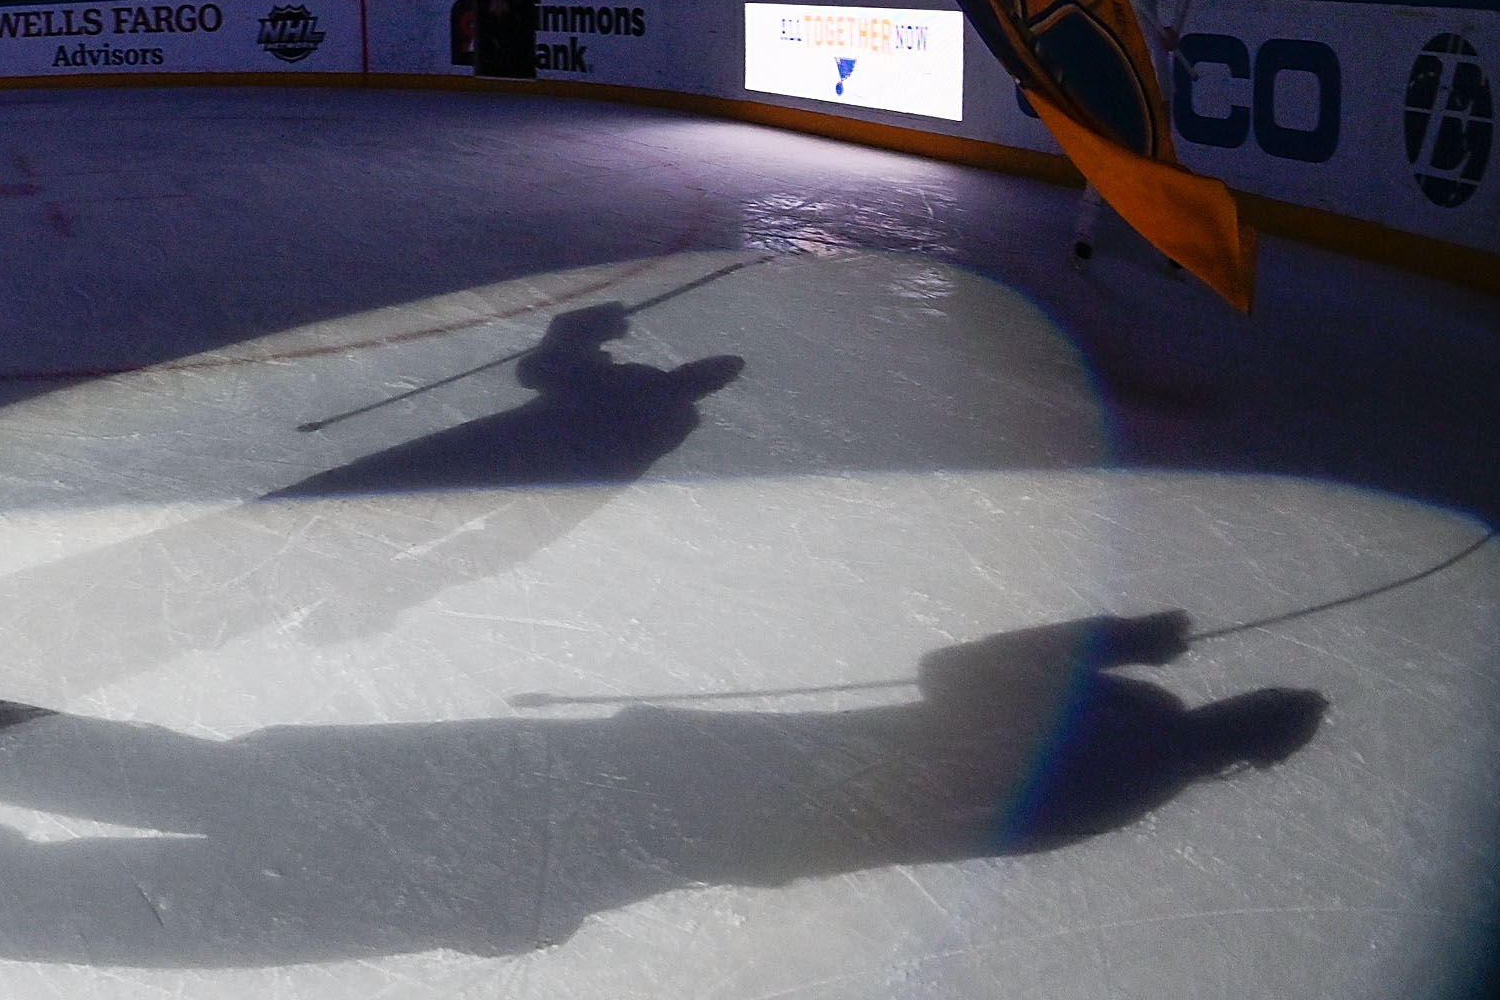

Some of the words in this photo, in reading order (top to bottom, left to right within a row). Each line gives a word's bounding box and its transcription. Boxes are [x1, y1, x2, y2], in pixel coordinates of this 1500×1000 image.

[112, 3, 224, 35] FARGO
[804, 15, 892, 55] TOGETHER
[52, 43, 164, 67] Advisors
[535, 37, 588, 73] ank
